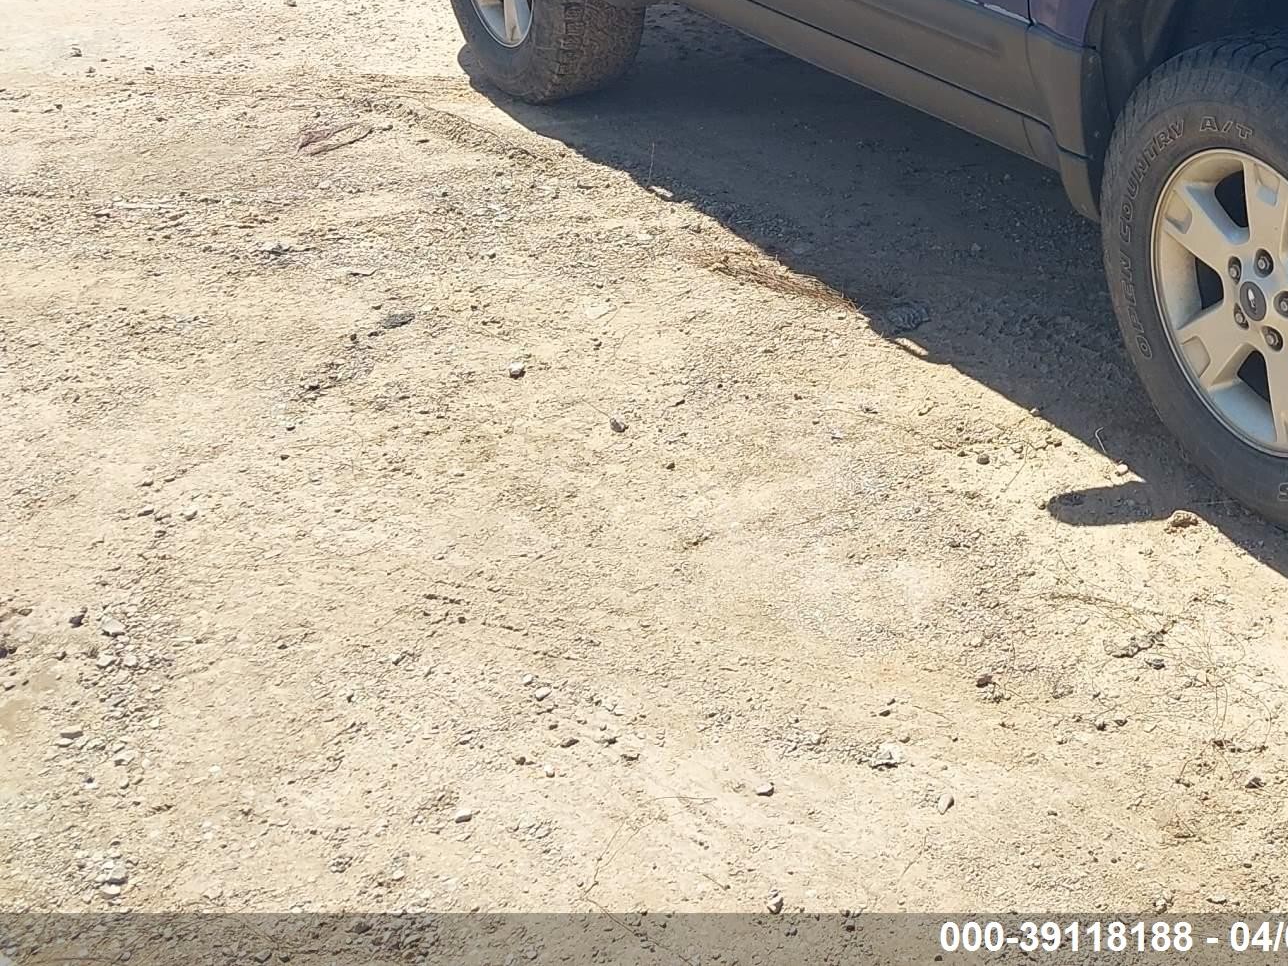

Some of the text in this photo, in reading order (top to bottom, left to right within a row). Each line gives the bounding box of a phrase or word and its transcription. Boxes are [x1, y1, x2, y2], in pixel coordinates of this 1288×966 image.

[1119, 114, 1254, 360] OPEN COUNTRY A/T
